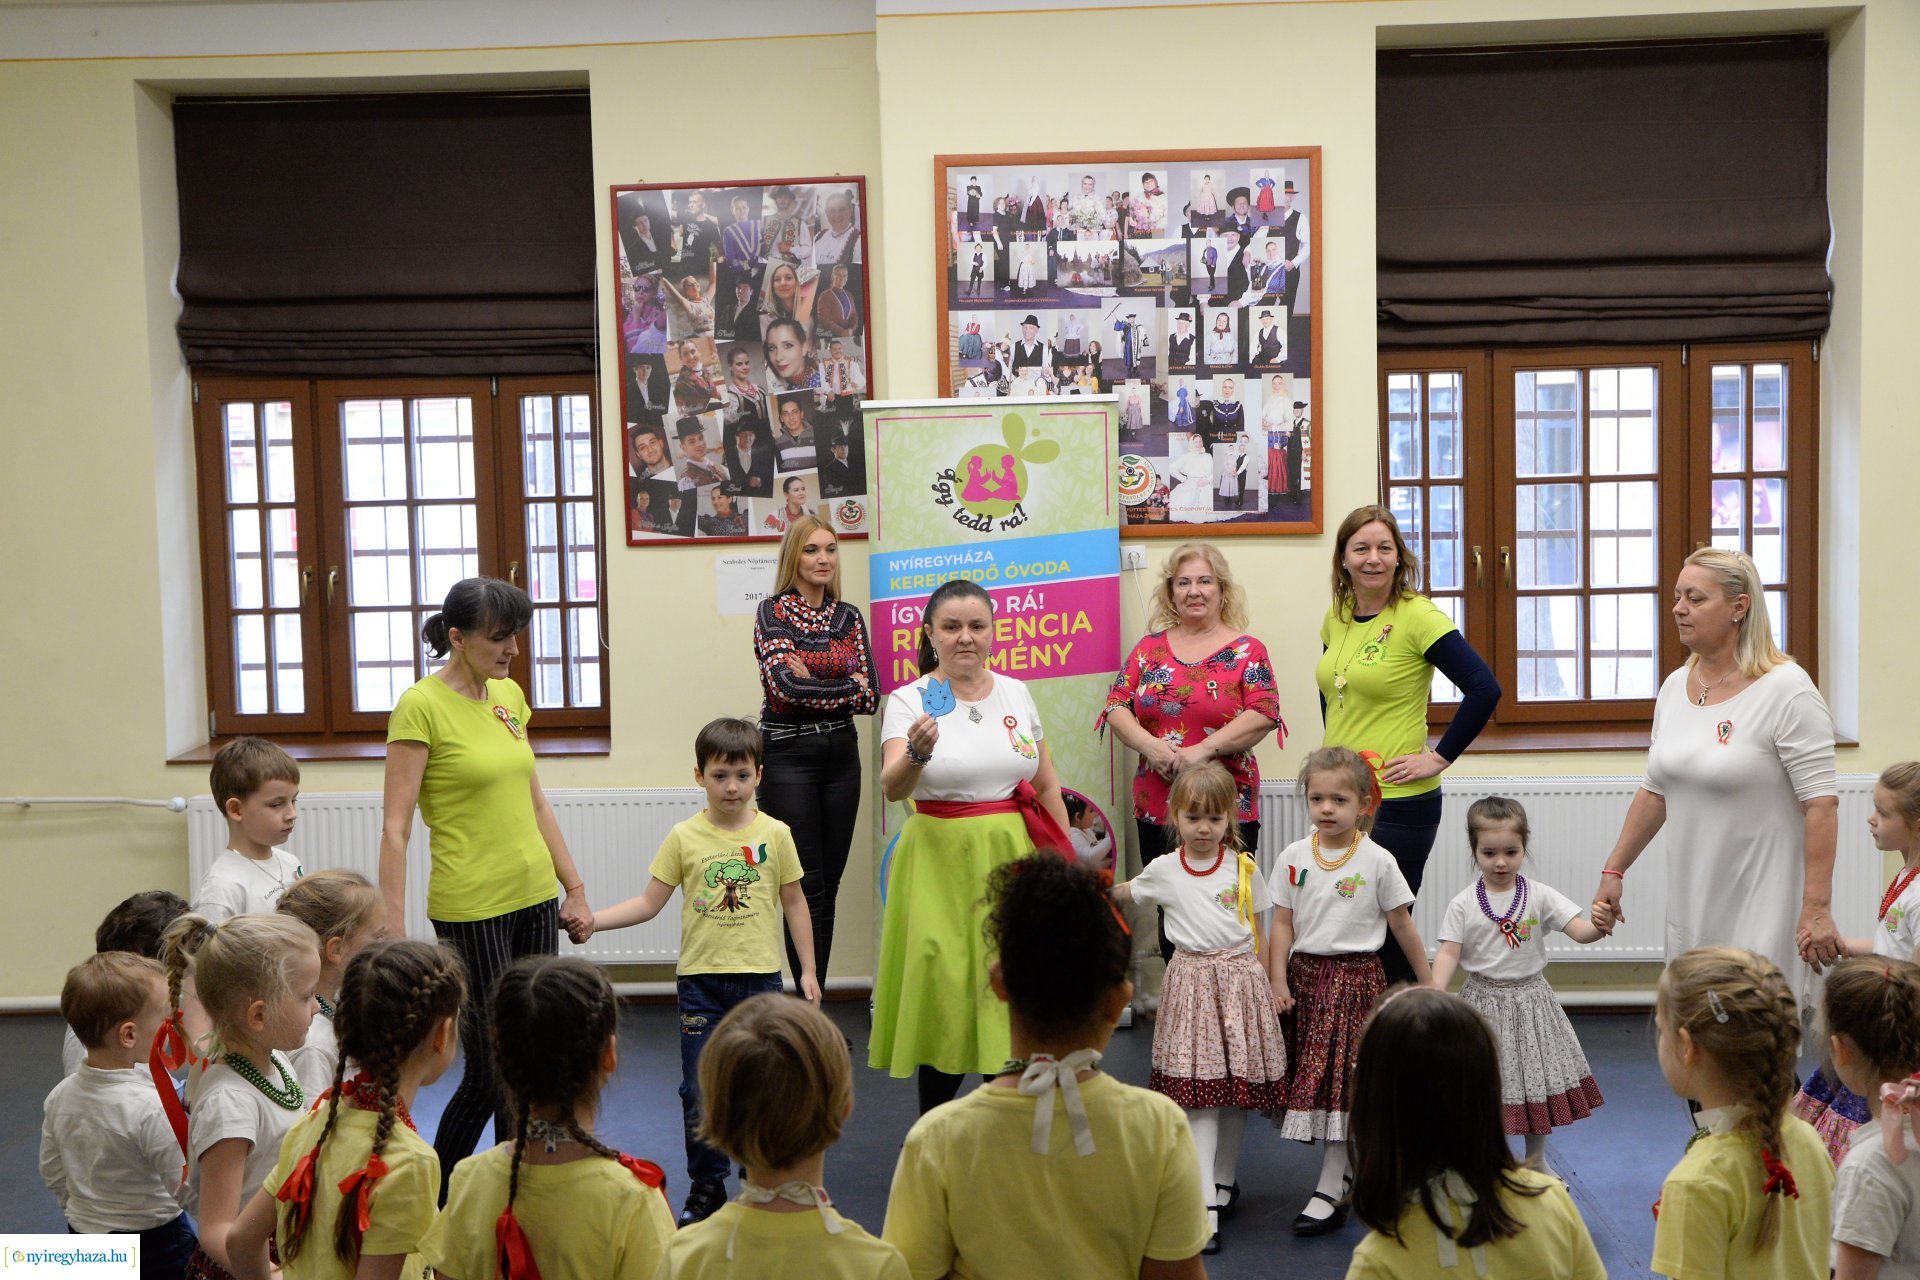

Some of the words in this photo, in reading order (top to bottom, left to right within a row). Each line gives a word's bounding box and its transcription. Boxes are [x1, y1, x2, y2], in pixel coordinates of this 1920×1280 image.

[952, 507, 993, 533] tedd
[999, 502, 1028, 532] rá!
[889, 549, 995, 572] NYÍREGYHÁZA
[1004, 560, 1071, 579] ÓVODA
[1006, 588, 1045, 614] RÁ!
[893, 640, 1073, 682] INMÉNY
